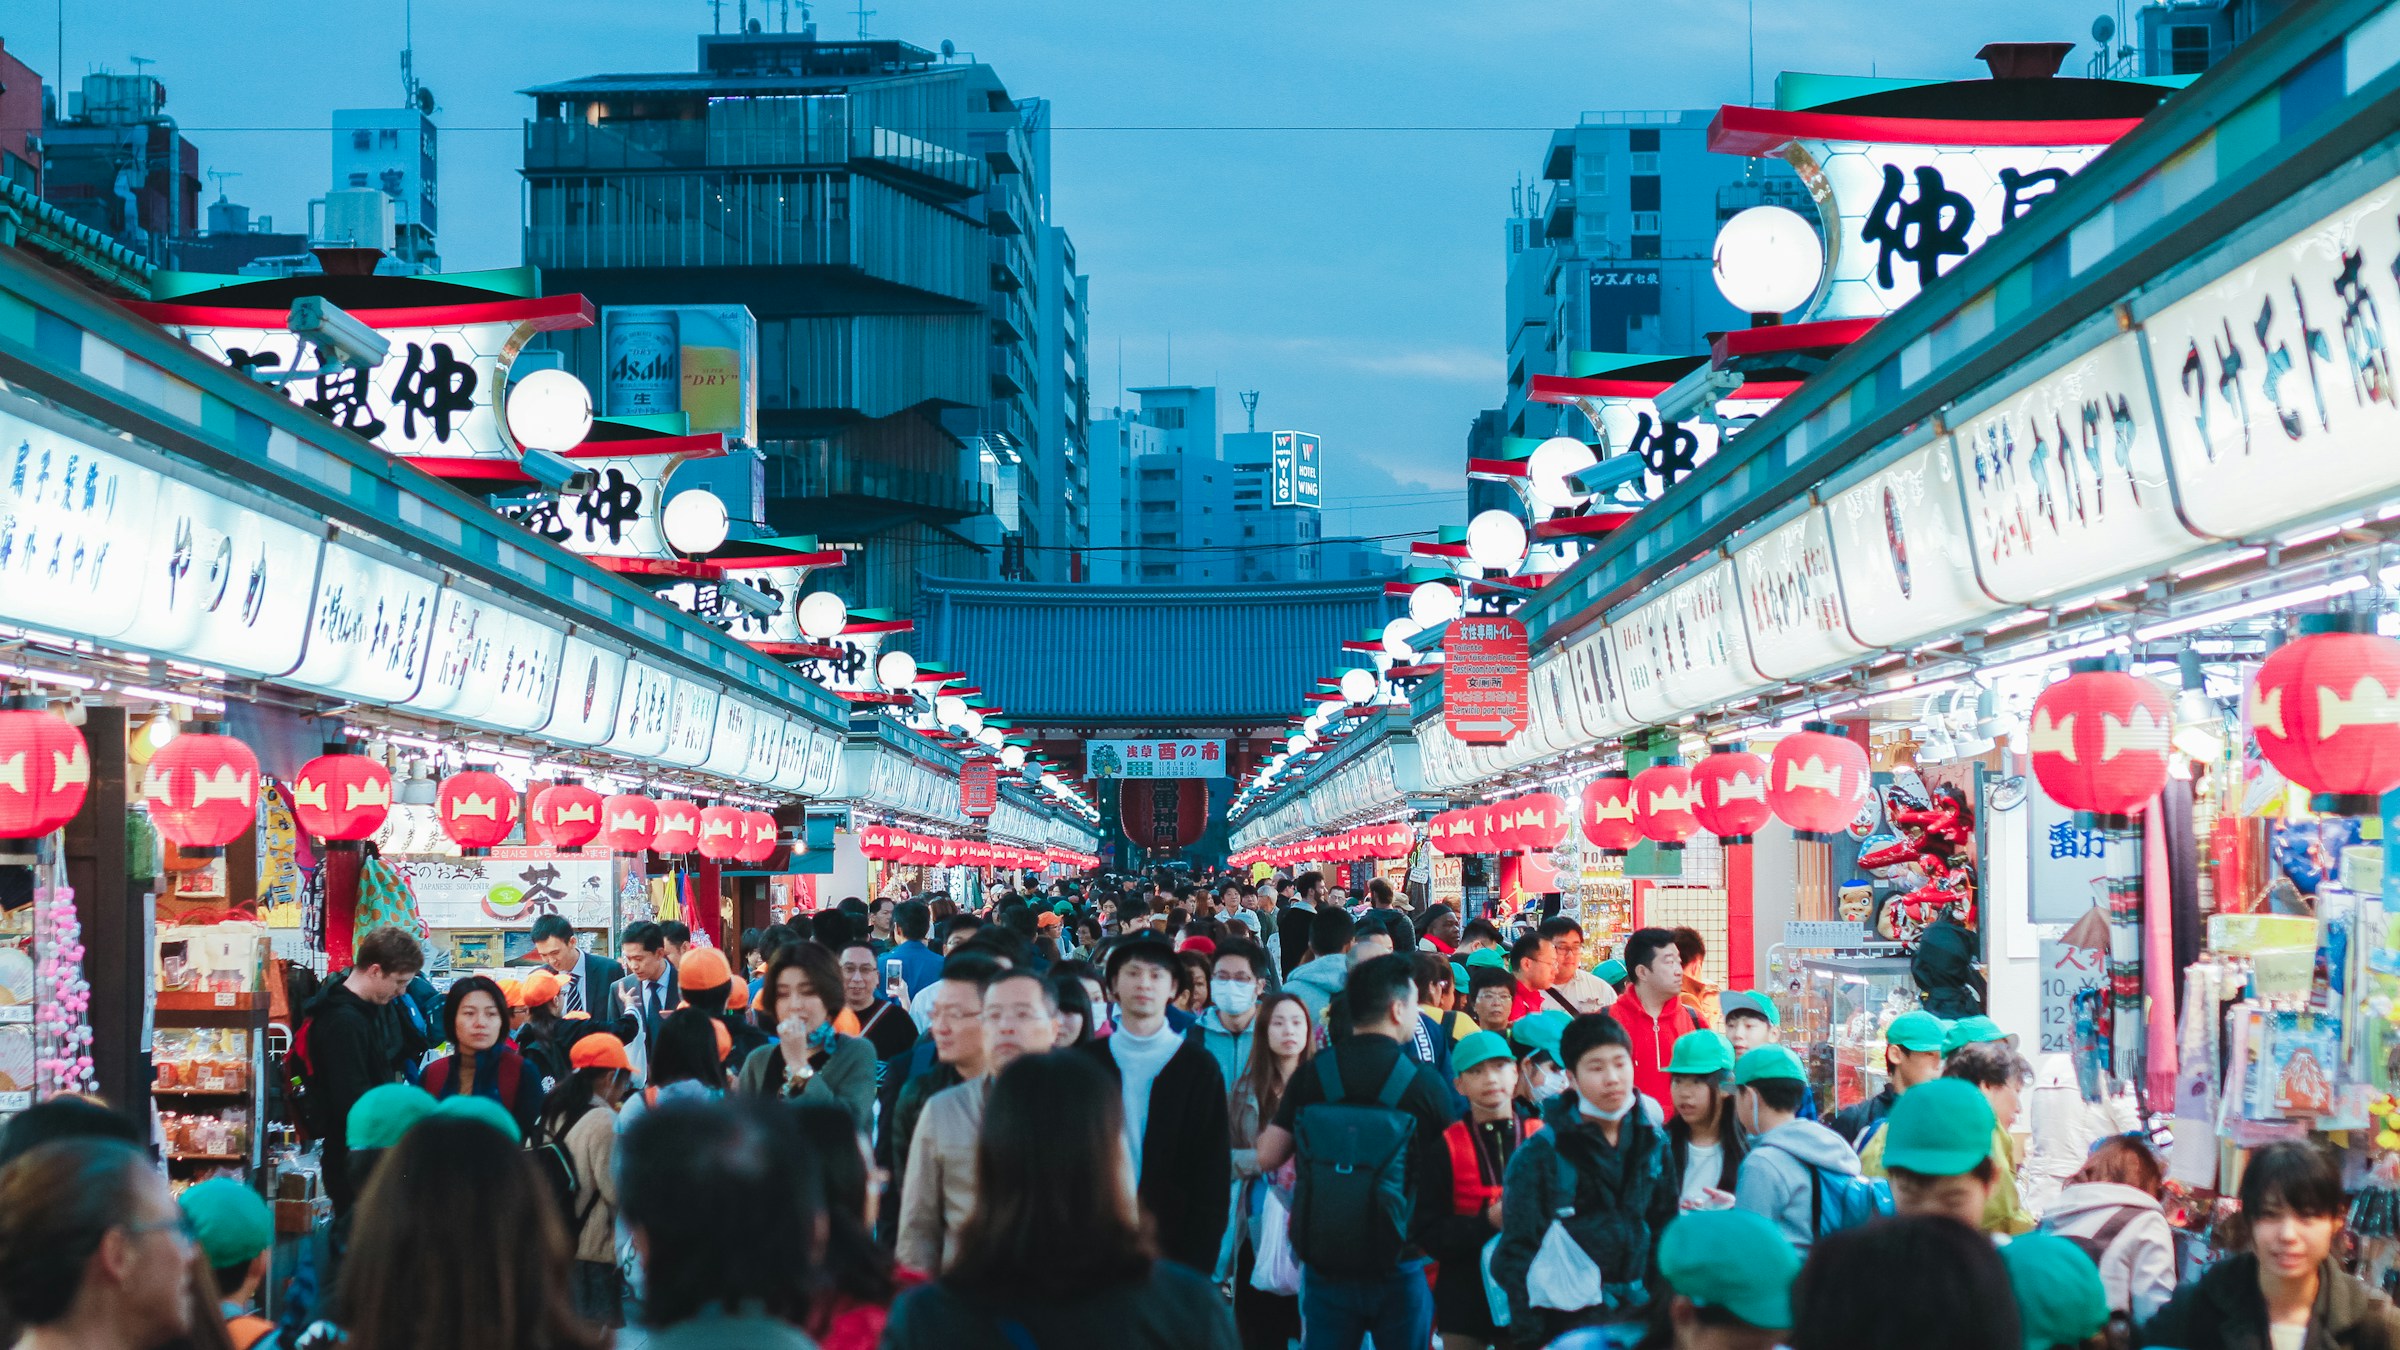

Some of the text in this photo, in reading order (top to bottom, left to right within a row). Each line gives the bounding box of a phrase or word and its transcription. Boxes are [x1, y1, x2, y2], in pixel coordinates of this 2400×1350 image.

[611, 353, 674, 382] Asahi
[633, 392, 651, 405] 生
[1277, 458, 1290, 499] WING
[1299, 465, 1316, 479] HOTEL
[1298, 480, 1318, 496] WING
[1460, 624, 1512, 640] 女性専用トイレ
[1453, 705, 1516, 716] Servicio por mujer
[1158, 742, 1219, 760] 酉の市
[1582, 852, 1624, 863] TOKY
[519, 862, 568, 915] 茶
[2042, 1006, 2065, 1024] 12
[2041, 1033, 2065, 1051] 24
